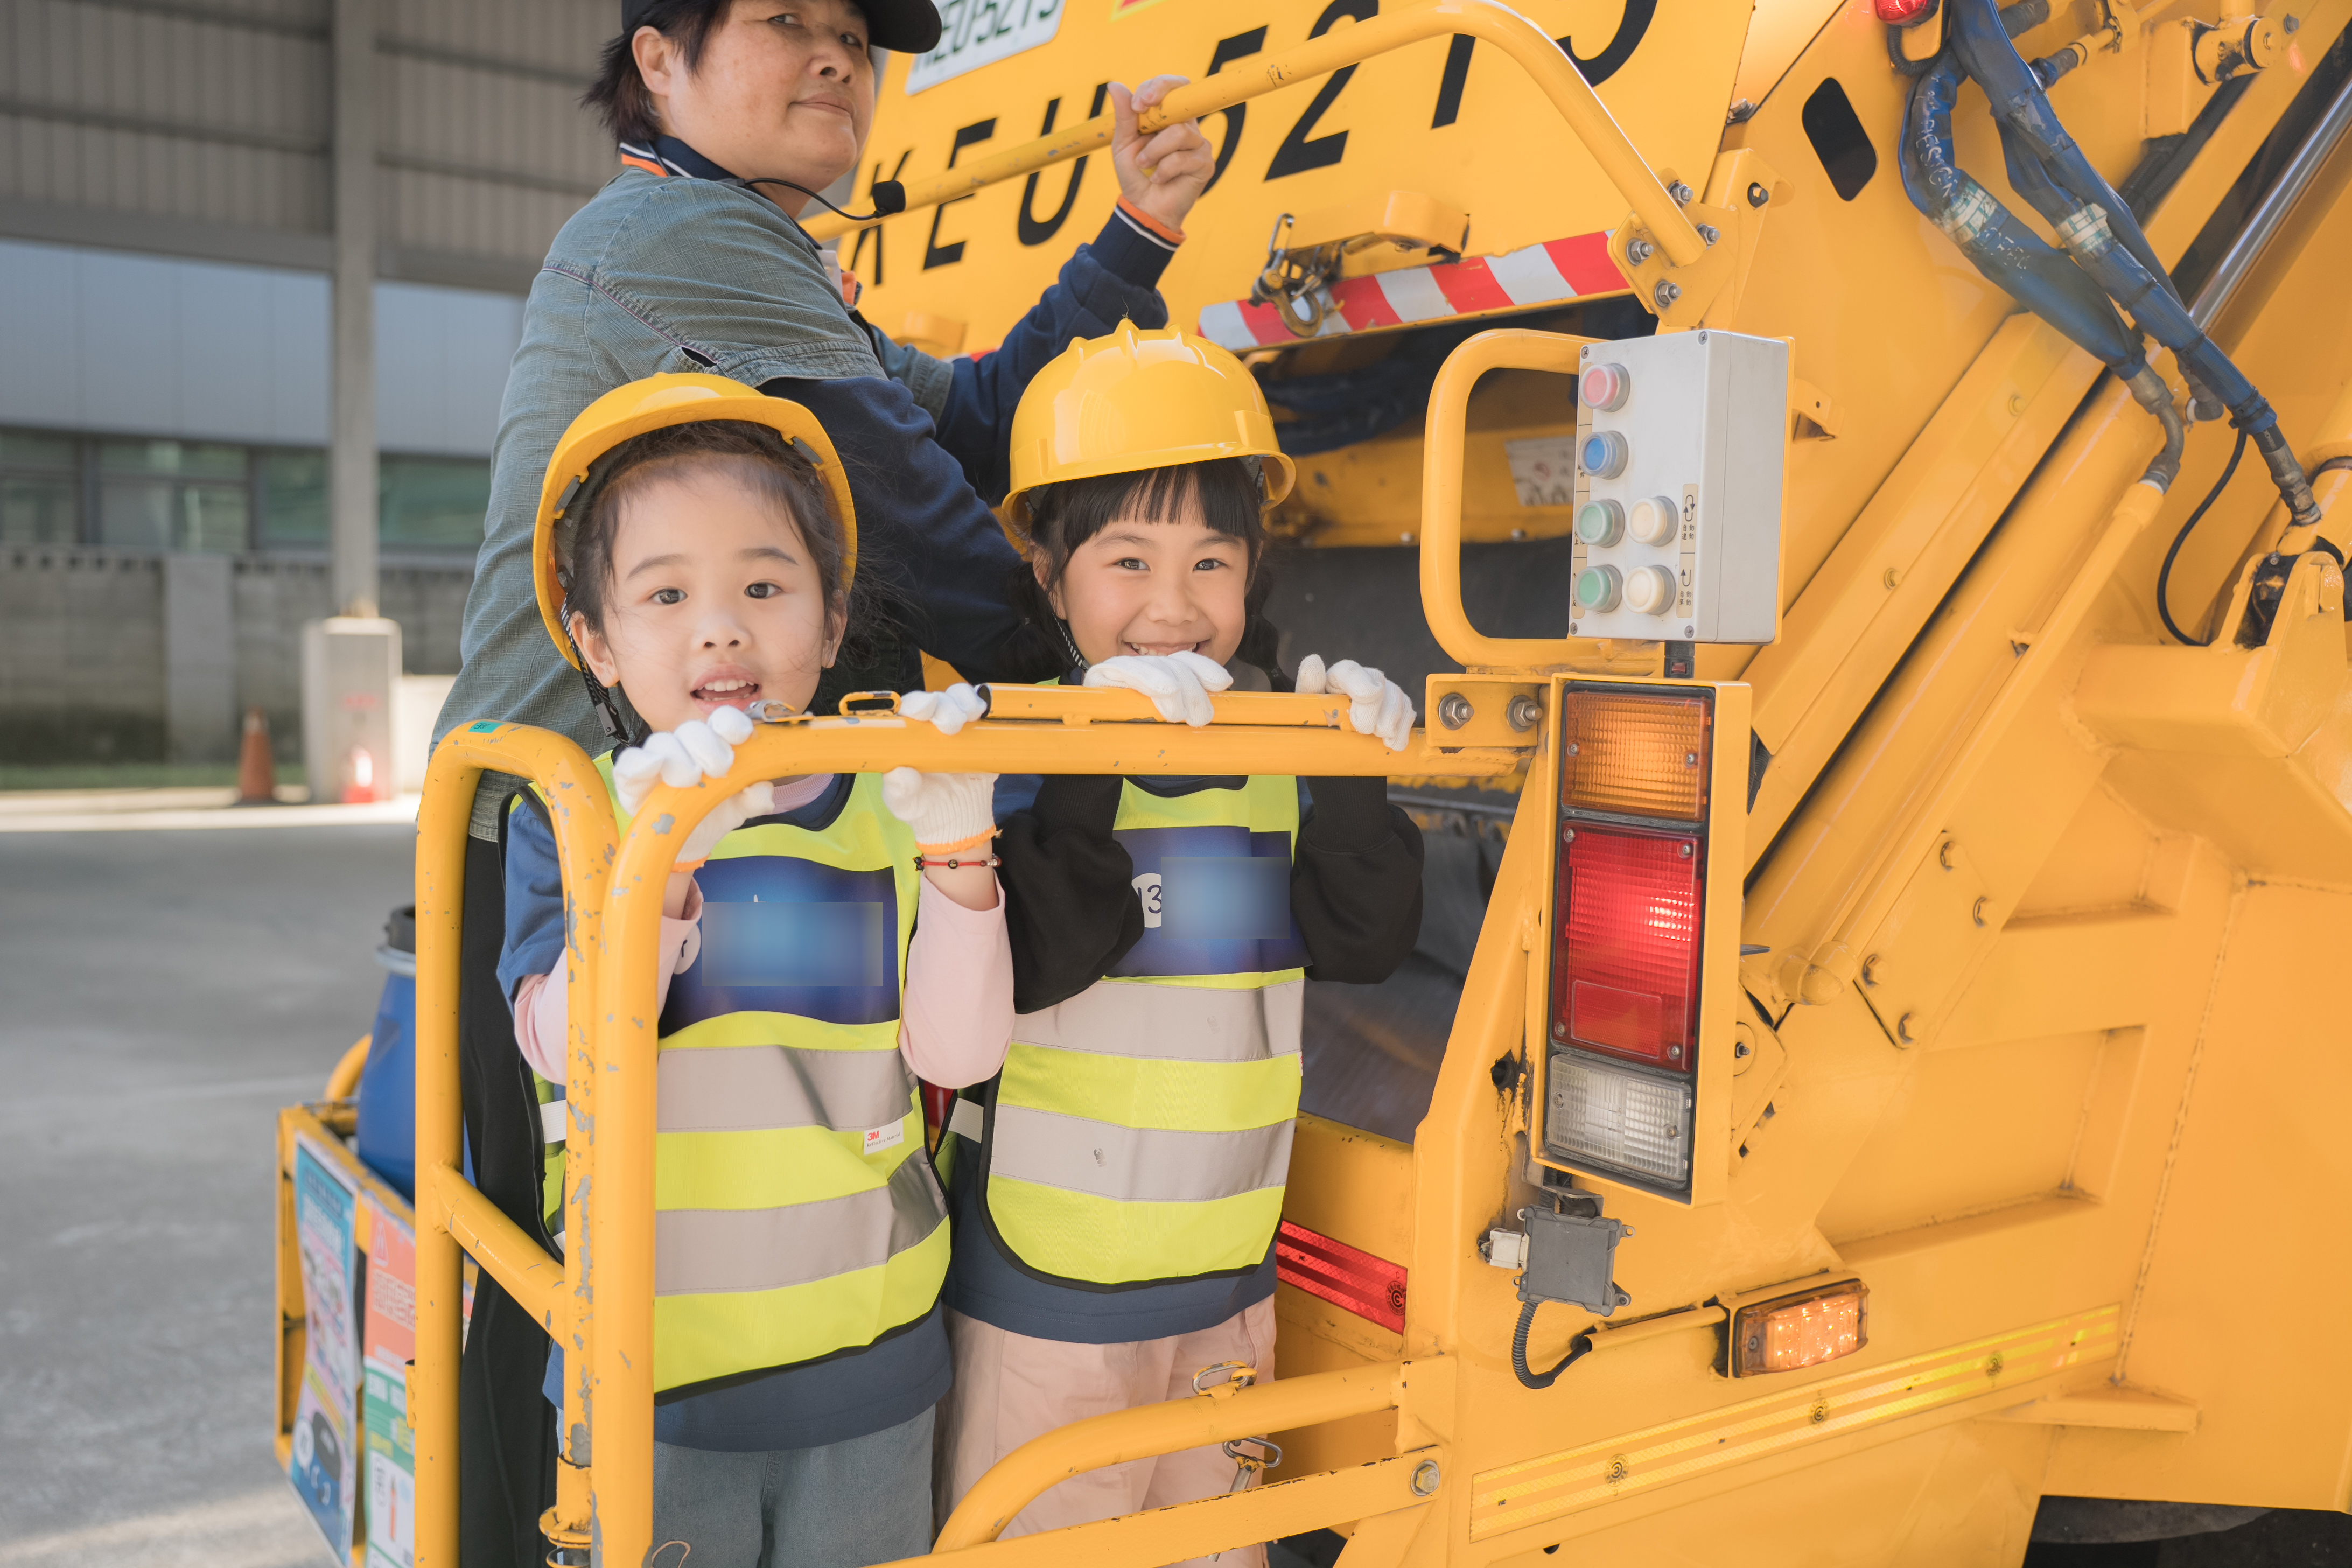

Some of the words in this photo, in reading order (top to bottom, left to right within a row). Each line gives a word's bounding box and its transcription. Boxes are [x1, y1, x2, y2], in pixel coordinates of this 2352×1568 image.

[1683, 524, 1695, 532] 自動
[866, 1138, 886, 1147] Reflective
[887, 1132, 900, 1141] Material
[867, 1130, 879, 1141] 3M
[1093, 1147, 1108, 1168] 3M
